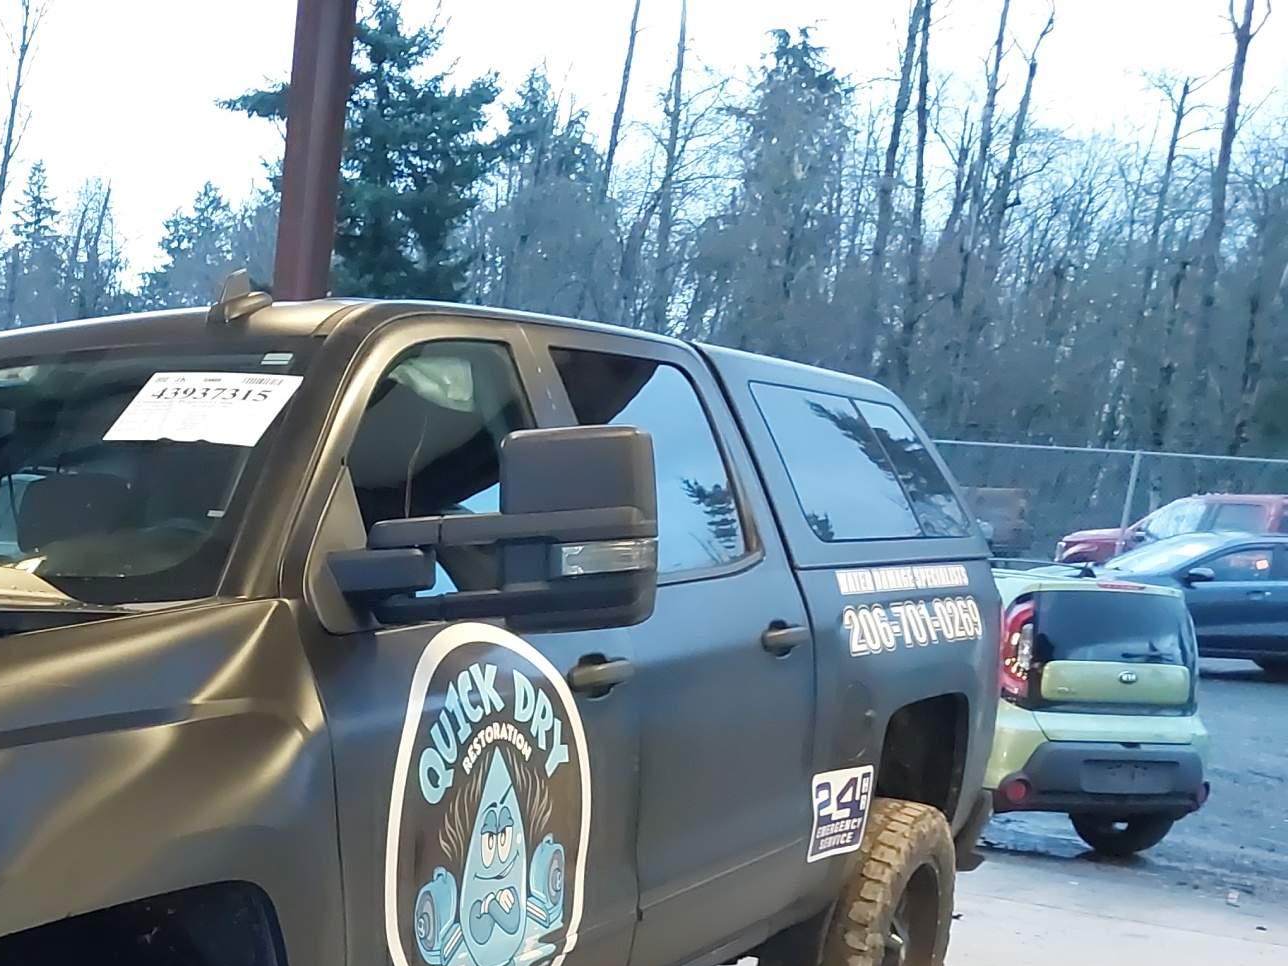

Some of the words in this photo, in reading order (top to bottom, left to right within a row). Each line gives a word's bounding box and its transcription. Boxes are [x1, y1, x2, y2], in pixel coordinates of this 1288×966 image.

[152, 386, 272, 401] 43937315
[843, 596, 982, 656] 206-701-0269
[418, 663, 504, 805] QUICK
[513, 669, 569, 778] DRY
[462, 722, 532, 775] RESTORATION
[816, 817, 863, 839] EMERGENCY
[819, 832, 854, 850] SERVICE
